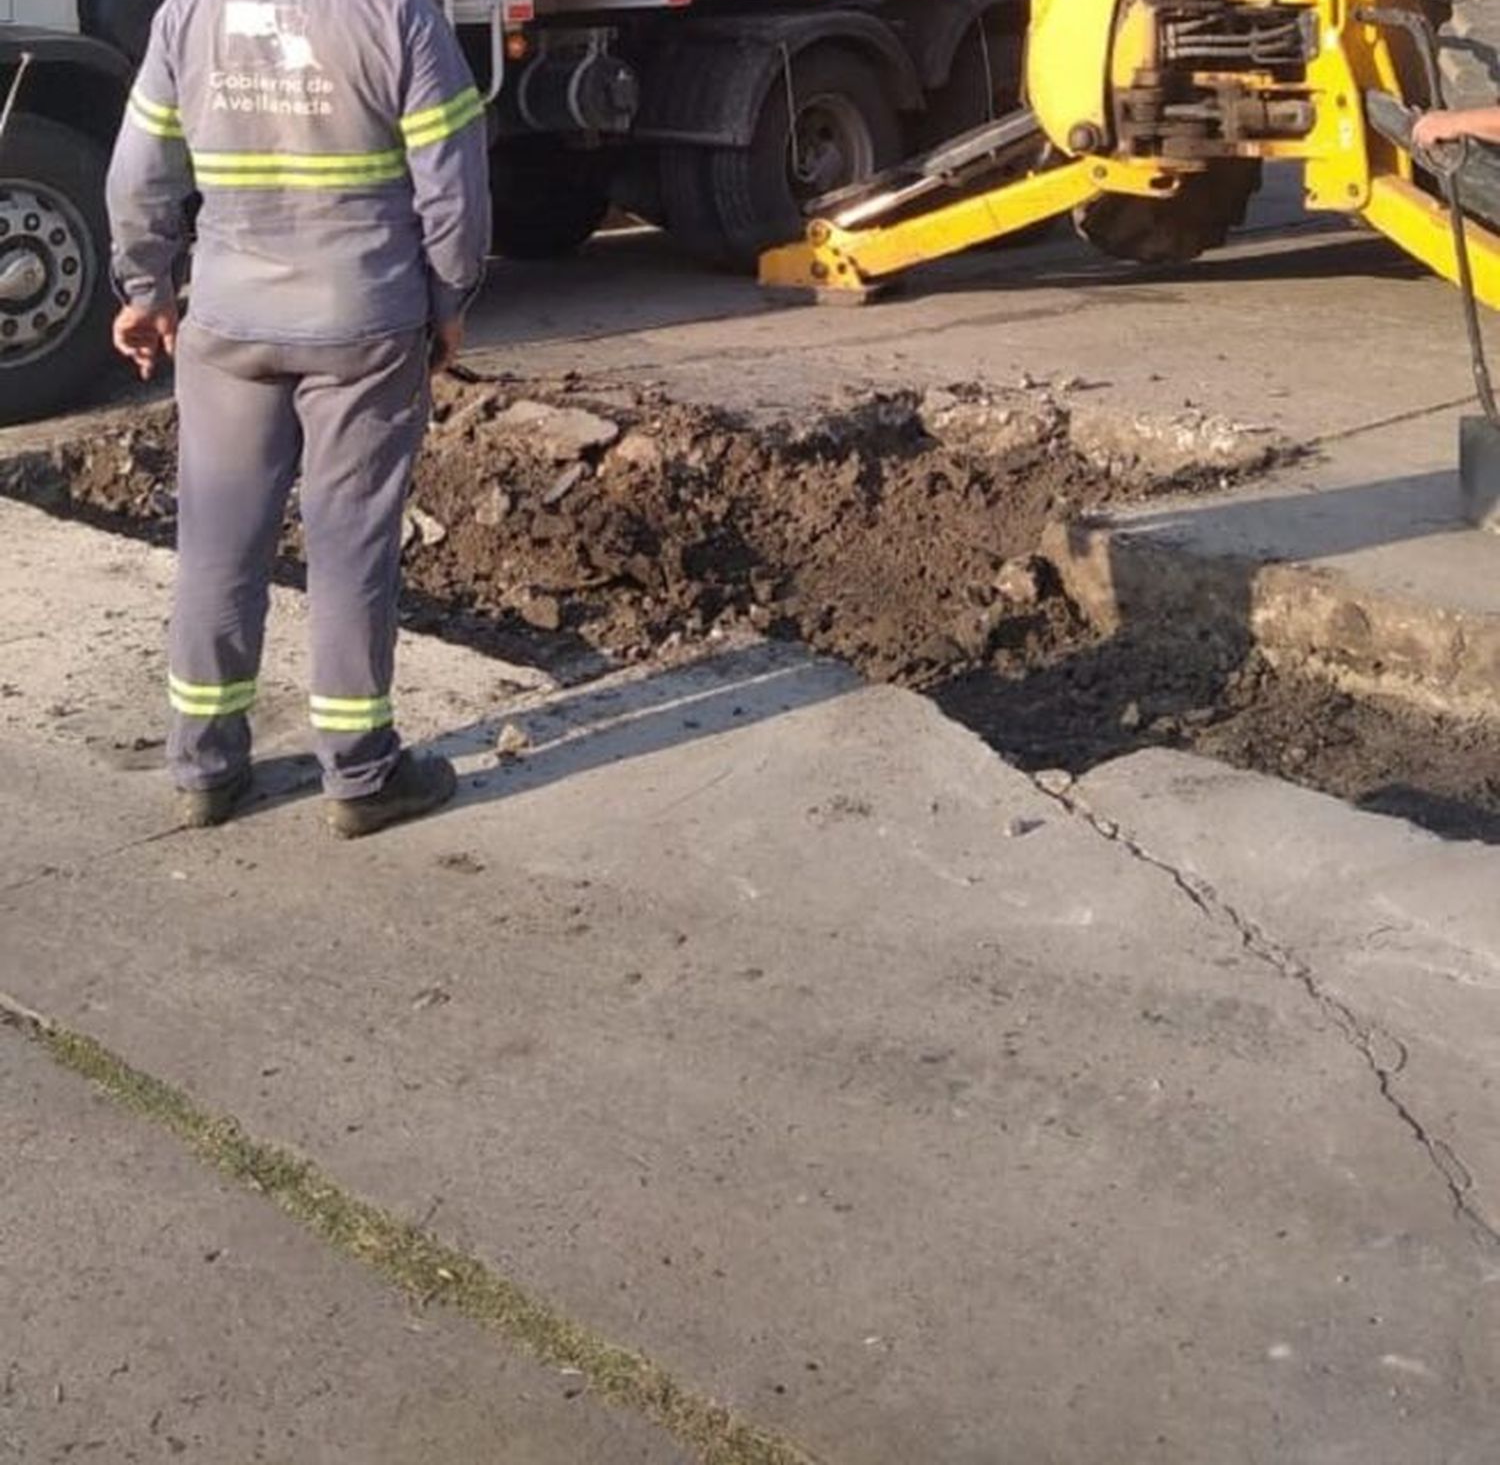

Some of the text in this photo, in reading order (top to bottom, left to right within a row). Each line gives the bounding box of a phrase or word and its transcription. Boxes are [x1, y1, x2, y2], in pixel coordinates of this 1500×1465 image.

[208, 72, 334, 95] Gobierno de
[211, 92, 333, 115] Avellaneda
